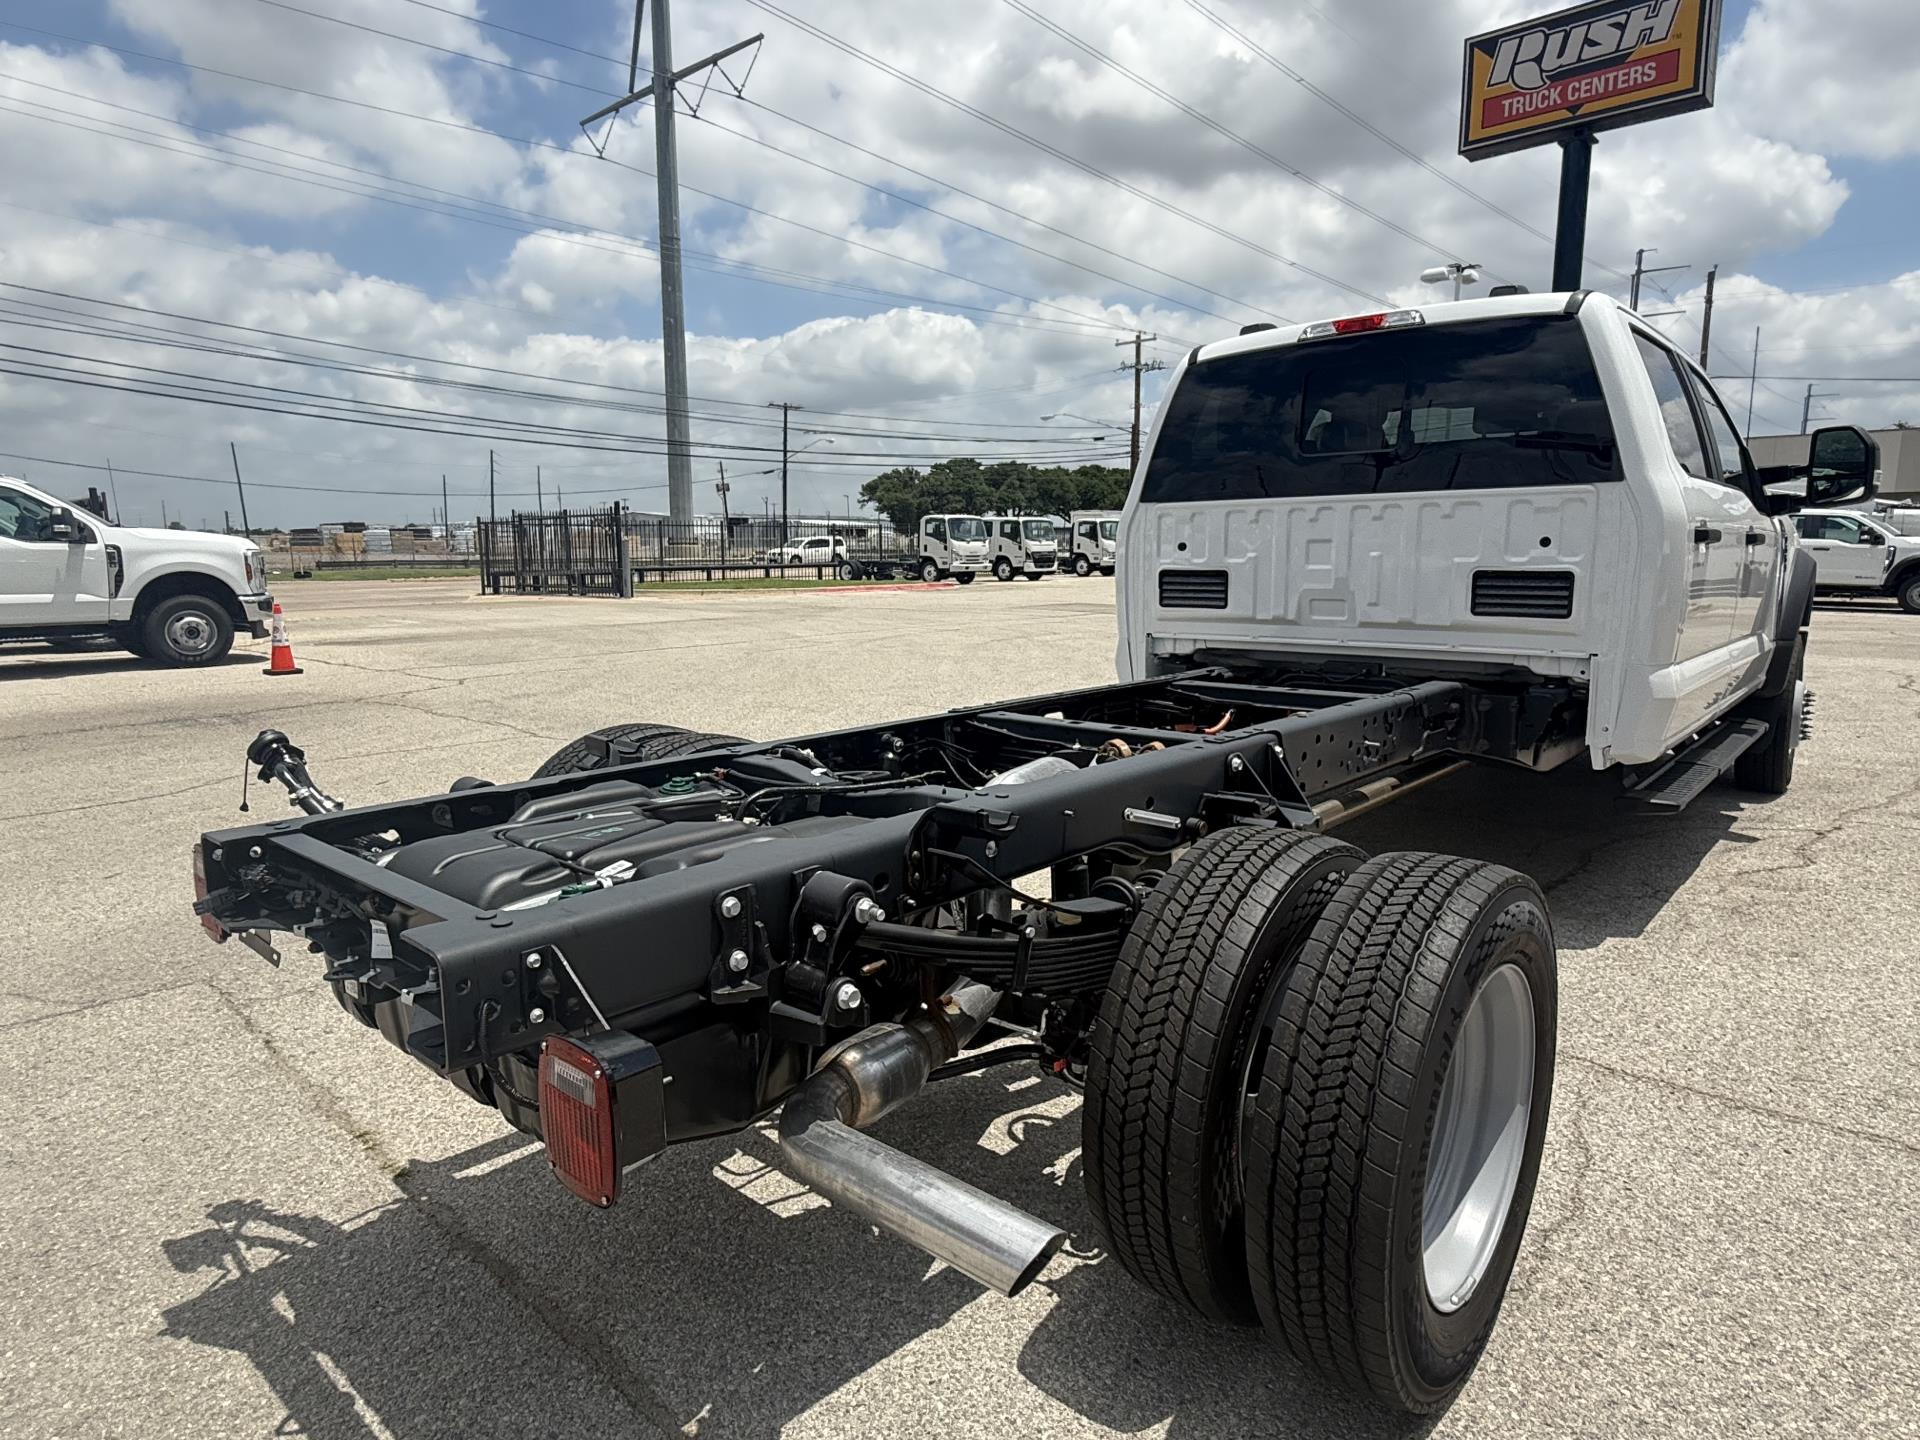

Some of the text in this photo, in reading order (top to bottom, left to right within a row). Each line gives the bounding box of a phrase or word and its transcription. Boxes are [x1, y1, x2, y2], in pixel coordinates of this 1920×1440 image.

[1486, 0, 1682, 92] RUSH
[1502, 62, 1656, 118] TRUCK CENTERS
